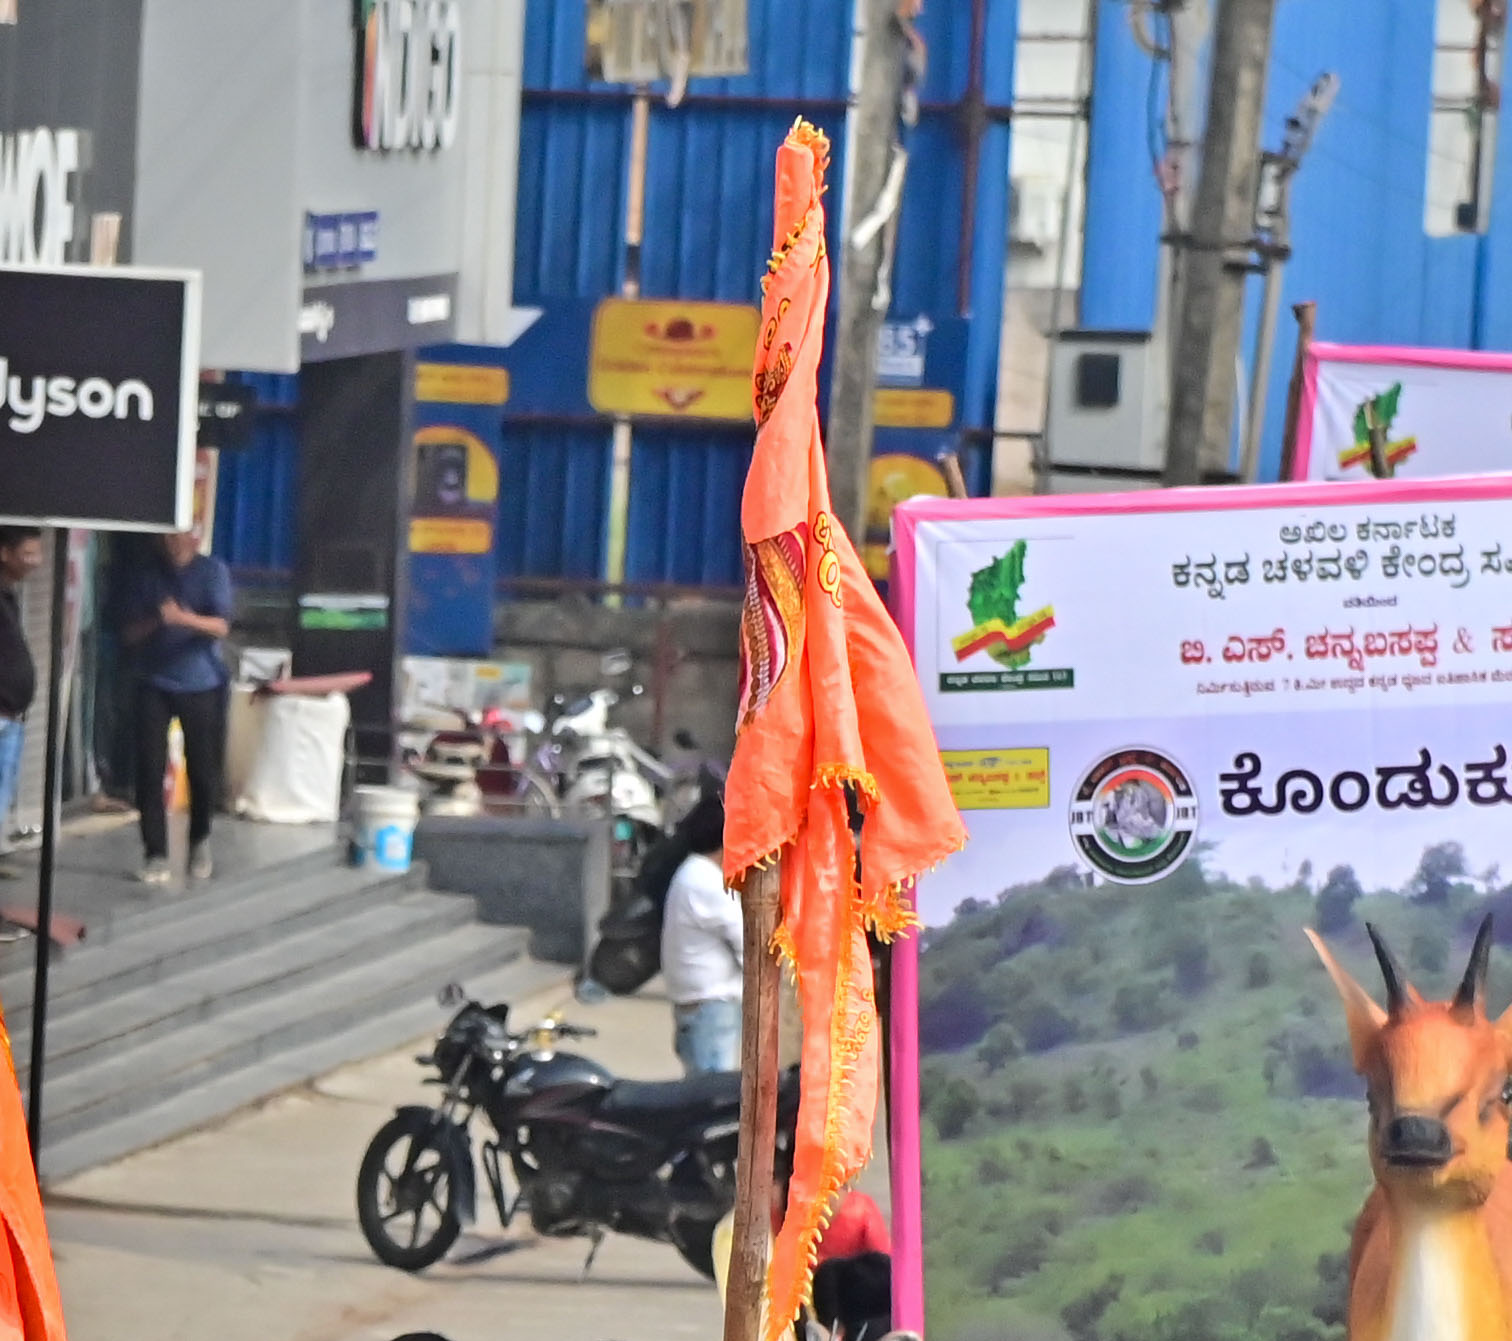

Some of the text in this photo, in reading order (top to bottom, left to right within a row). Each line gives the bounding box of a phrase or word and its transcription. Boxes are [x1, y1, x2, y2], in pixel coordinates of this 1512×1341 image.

[1279, 513, 1458, 546] ಅಖಿಲ ಕರ್ನಾಟಕ
[1172, 554, 1250, 599] ಕನ್ನಡ
[1262, 547, 1370, 585] ಚಳವಳಿ
[1381, 543, 1471, 590] ಕೇಂದ್ರ
[1222, 627, 1294, 664] ಎಸ್.
[1304, 622, 1440, 674] ಚನ್ನಬಸಪ್ಪ
[1453, 633, 1476, 655] &
